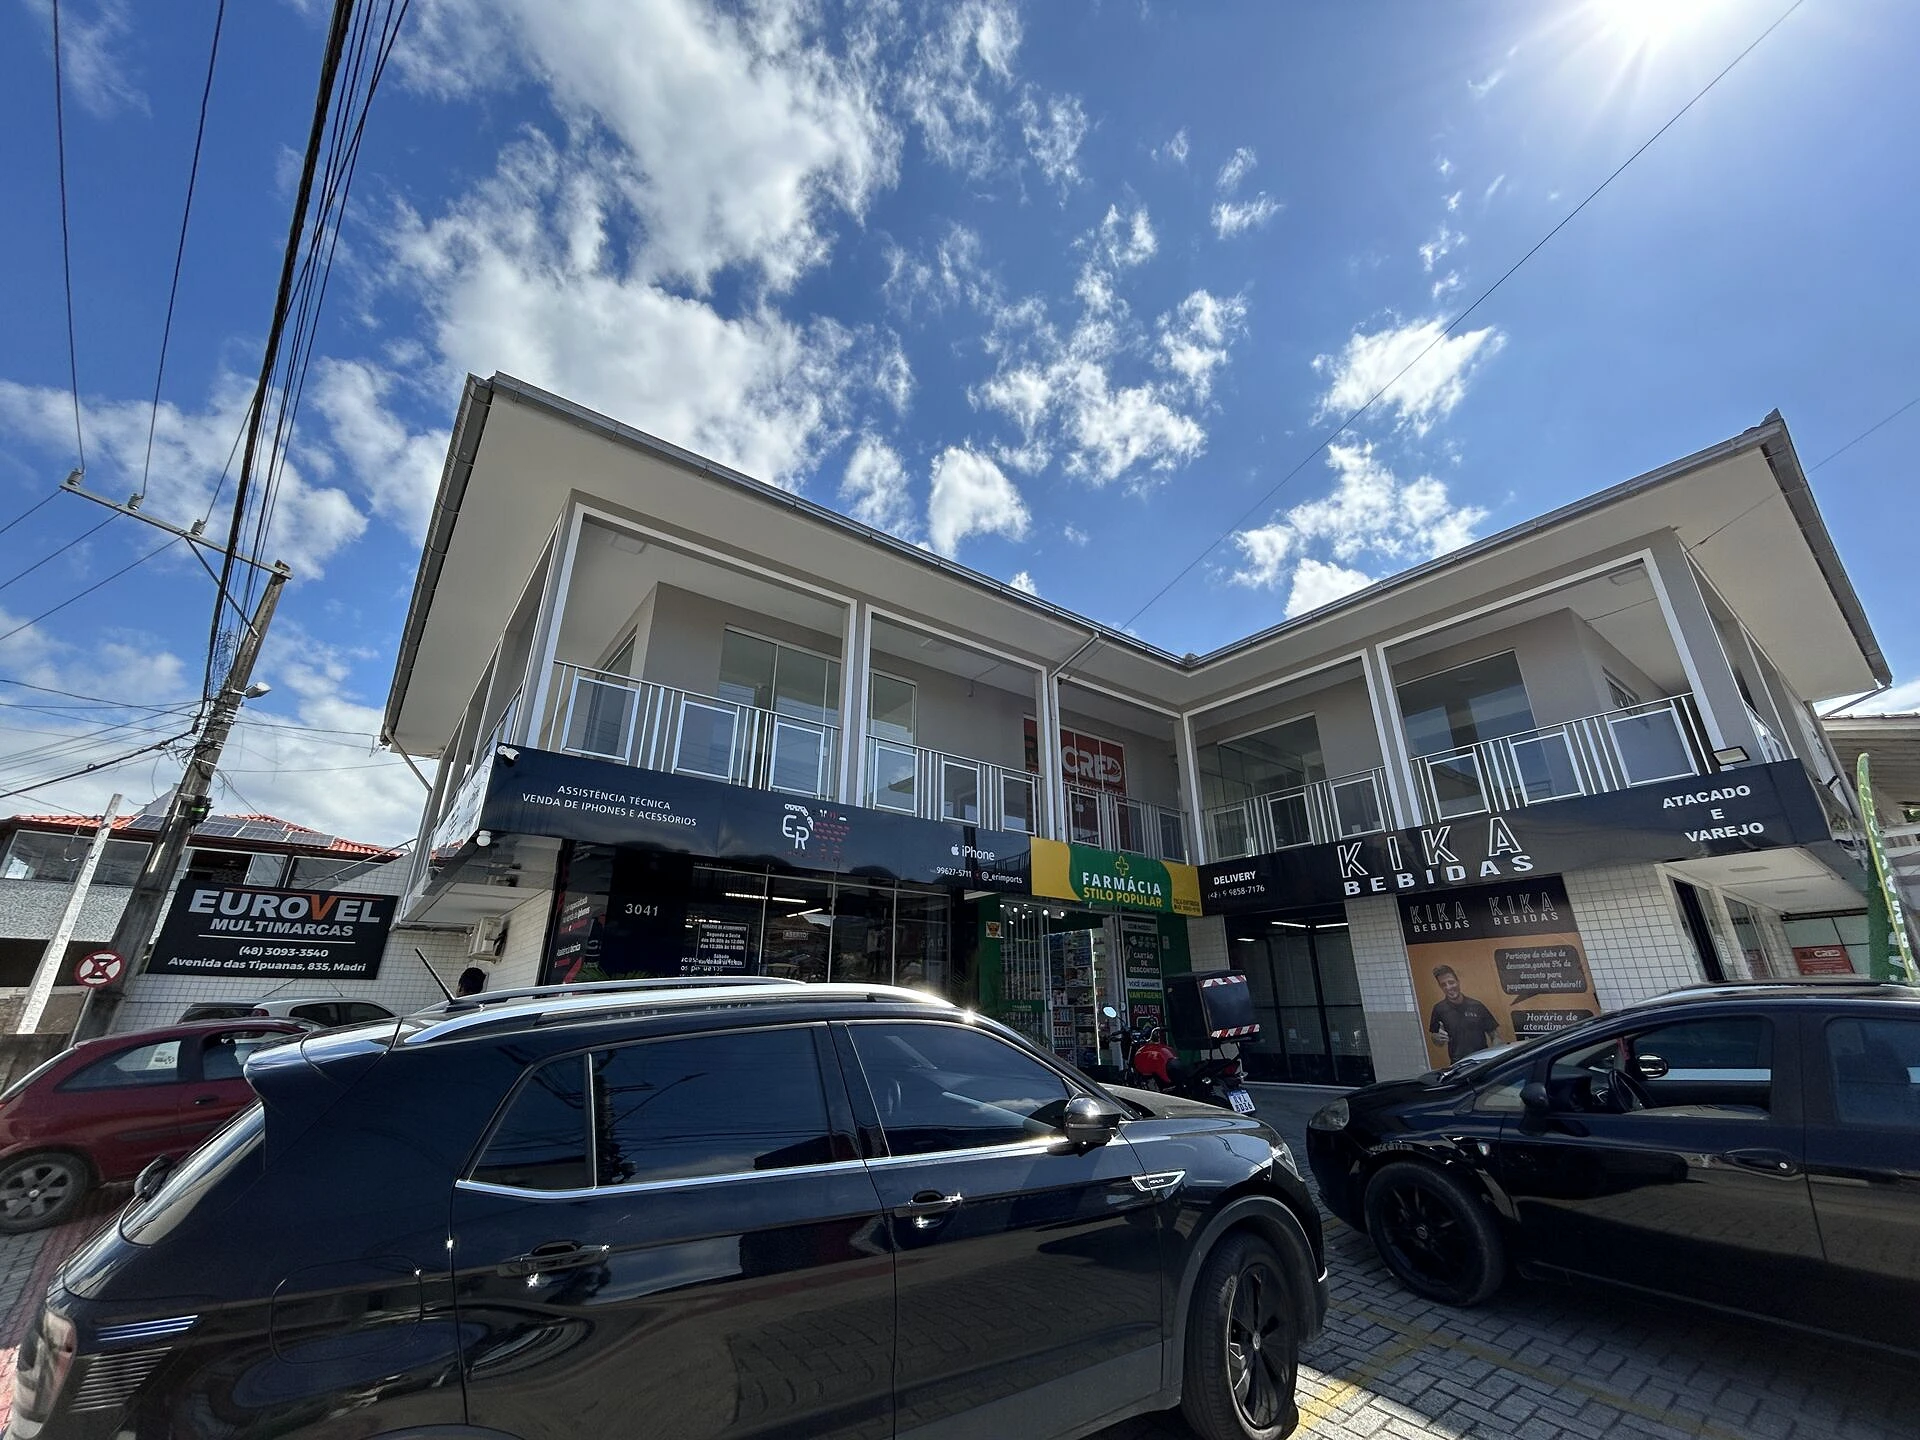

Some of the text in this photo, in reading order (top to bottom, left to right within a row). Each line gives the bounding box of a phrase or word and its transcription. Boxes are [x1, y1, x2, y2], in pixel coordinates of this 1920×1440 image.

[557, 785, 671, 810] ASSISTÊNCIA TÉCNICA
[1662, 785, 1751, 809] ATACADO
[522, 793, 697, 827] VENDA DE IPHONES E ACESSÓRIOS
[1710, 808, 1725, 820] E
[1684, 822, 1765, 842] VAREJO
[961, 845, 995, 861] iPhone
[1337, 816, 1523, 879] KIKA
[936, 866, 972, 878] 99627-5711
[981, 871, 1023, 884] @_erimports
[1082, 871, 1162, 896] FARMÁCIA
[1213, 870, 1256, 886] DELIVERY
[1343, 855, 1535, 896] BEBIDAS
[1083, 886, 1114, 901] STILO
[1116, 891, 1163, 908] POPULAR
[1228, 884, 1266, 896] 9858-7176
[188, 889, 381, 923] EUROVEL
[625, 903, 659, 917] 3041
[1410, 901, 1466, 924] KIKA
[1489, 891, 1555, 917] KIKA
[210, 918, 354, 937] MULTIMARCAS
[1413, 919, 1471, 933] BEBIDAS
[1494, 912, 1559, 926] BEBIDAS
[239, 946, 329, 957] (48) 3093-3540
[167, 957, 367, 972] Avenida das Tipuanas, 835, Madri
[1526, 1012, 1578, 1022] Horário de
[1523, 1023, 1567, 1032] atendime
